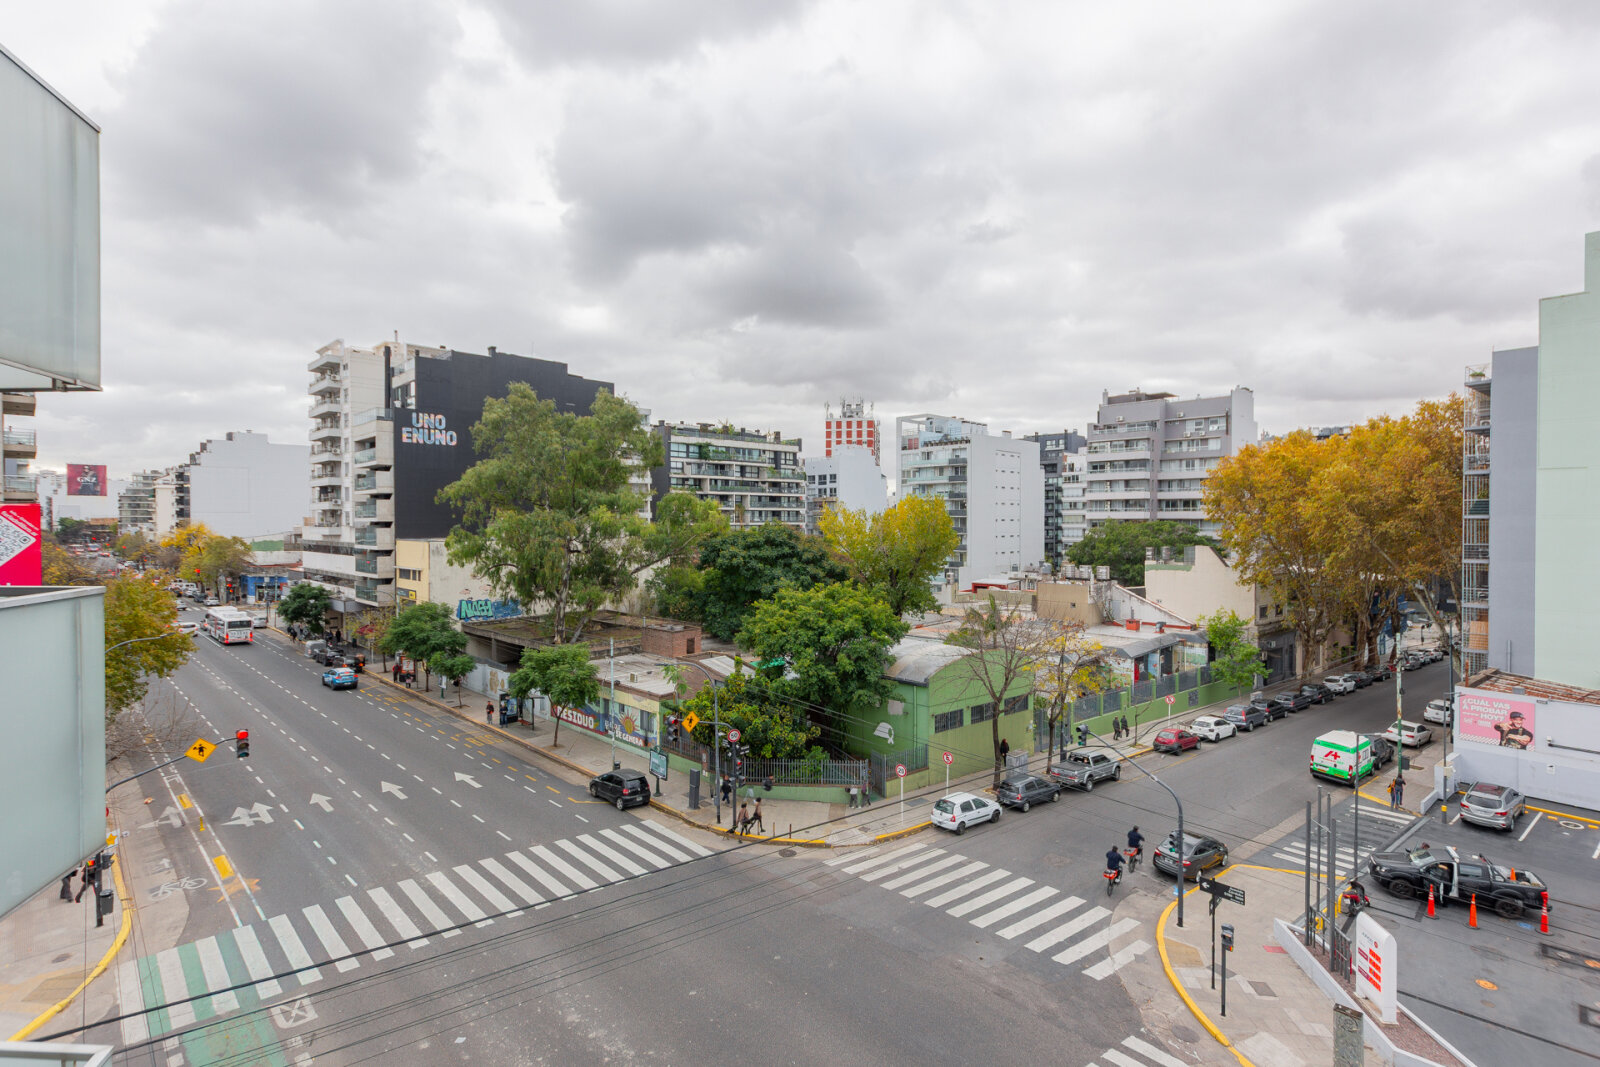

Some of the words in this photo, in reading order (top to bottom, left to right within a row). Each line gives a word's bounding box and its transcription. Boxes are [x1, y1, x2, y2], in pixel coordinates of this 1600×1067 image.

[411, 411, 446, 430] UNO
[401, 427, 458, 446] ENUNO
[1470, 705, 1508, 716] PROBAR
[1493, 701, 1511, 710] VAS
[556, 705, 594, 729] RESIDUO
